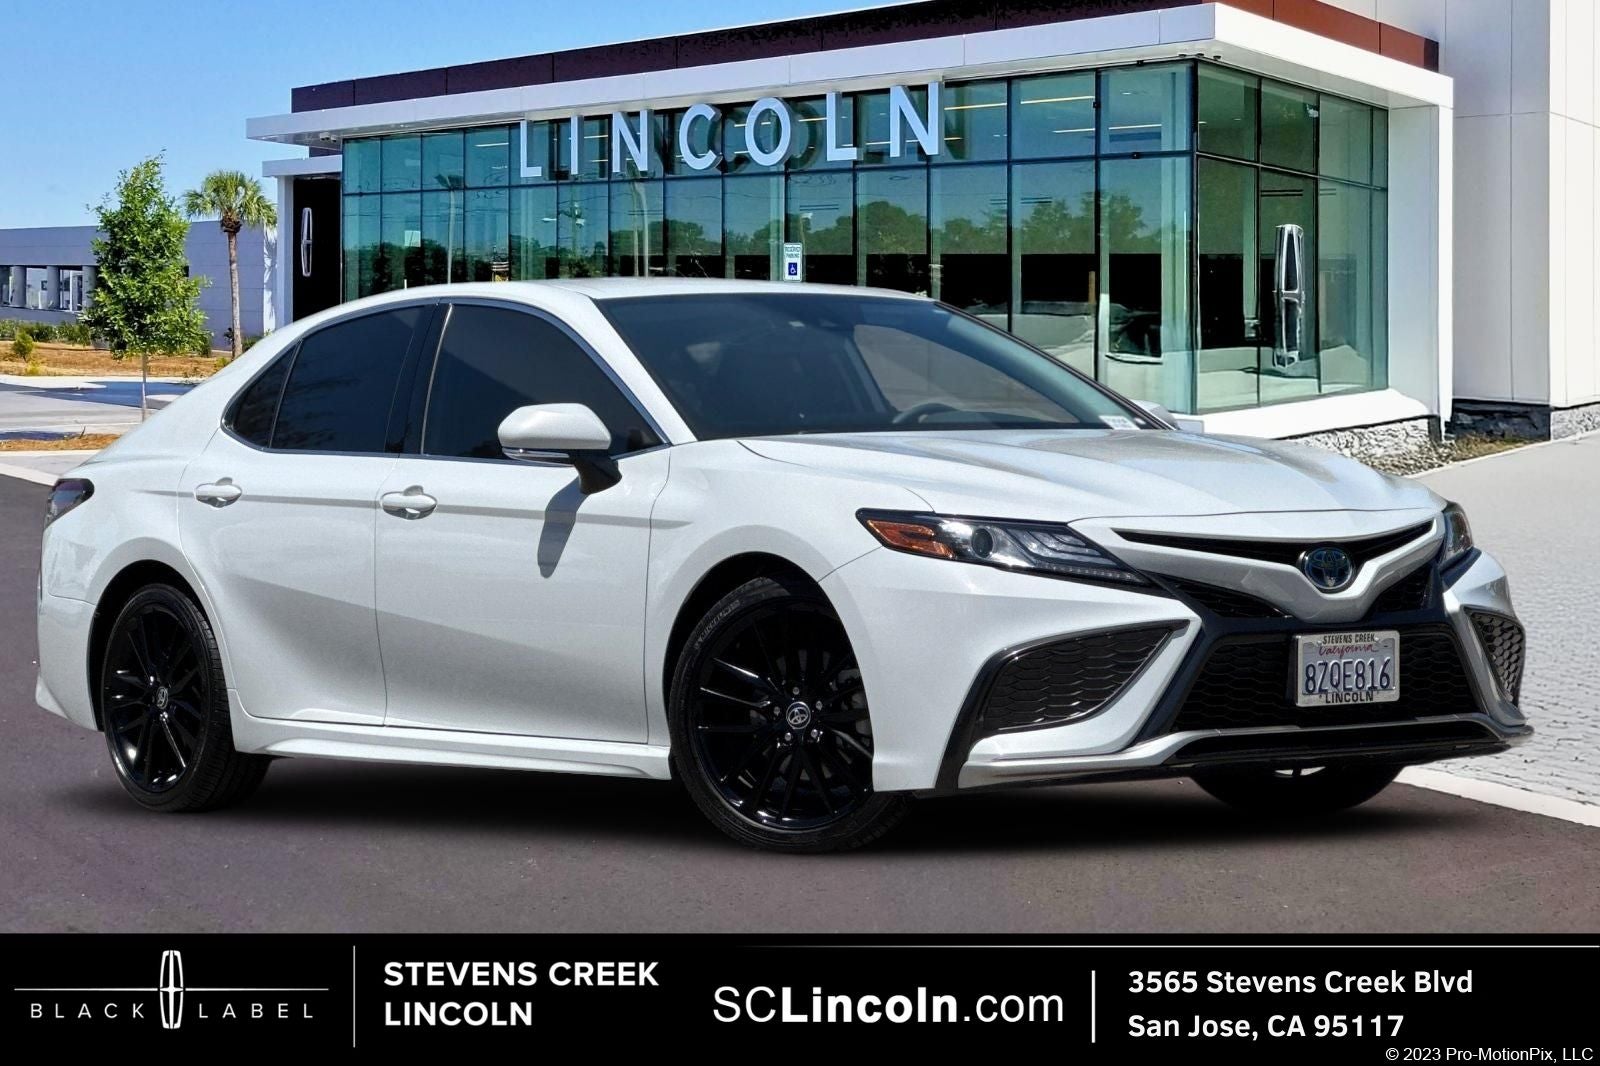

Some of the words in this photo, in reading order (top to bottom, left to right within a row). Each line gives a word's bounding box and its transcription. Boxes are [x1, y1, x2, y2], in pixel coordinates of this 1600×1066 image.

[519, 81, 943, 178] LINCOLN
[1322, 634, 1353, 645] STEVENS
[1354, 633, 1375, 643] CREEK
[1319, 643, 1379, 657] California
[1304, 657, 1391, 694] 8ZQE816
[1325, 691, 1374, 704] LINCOLN
